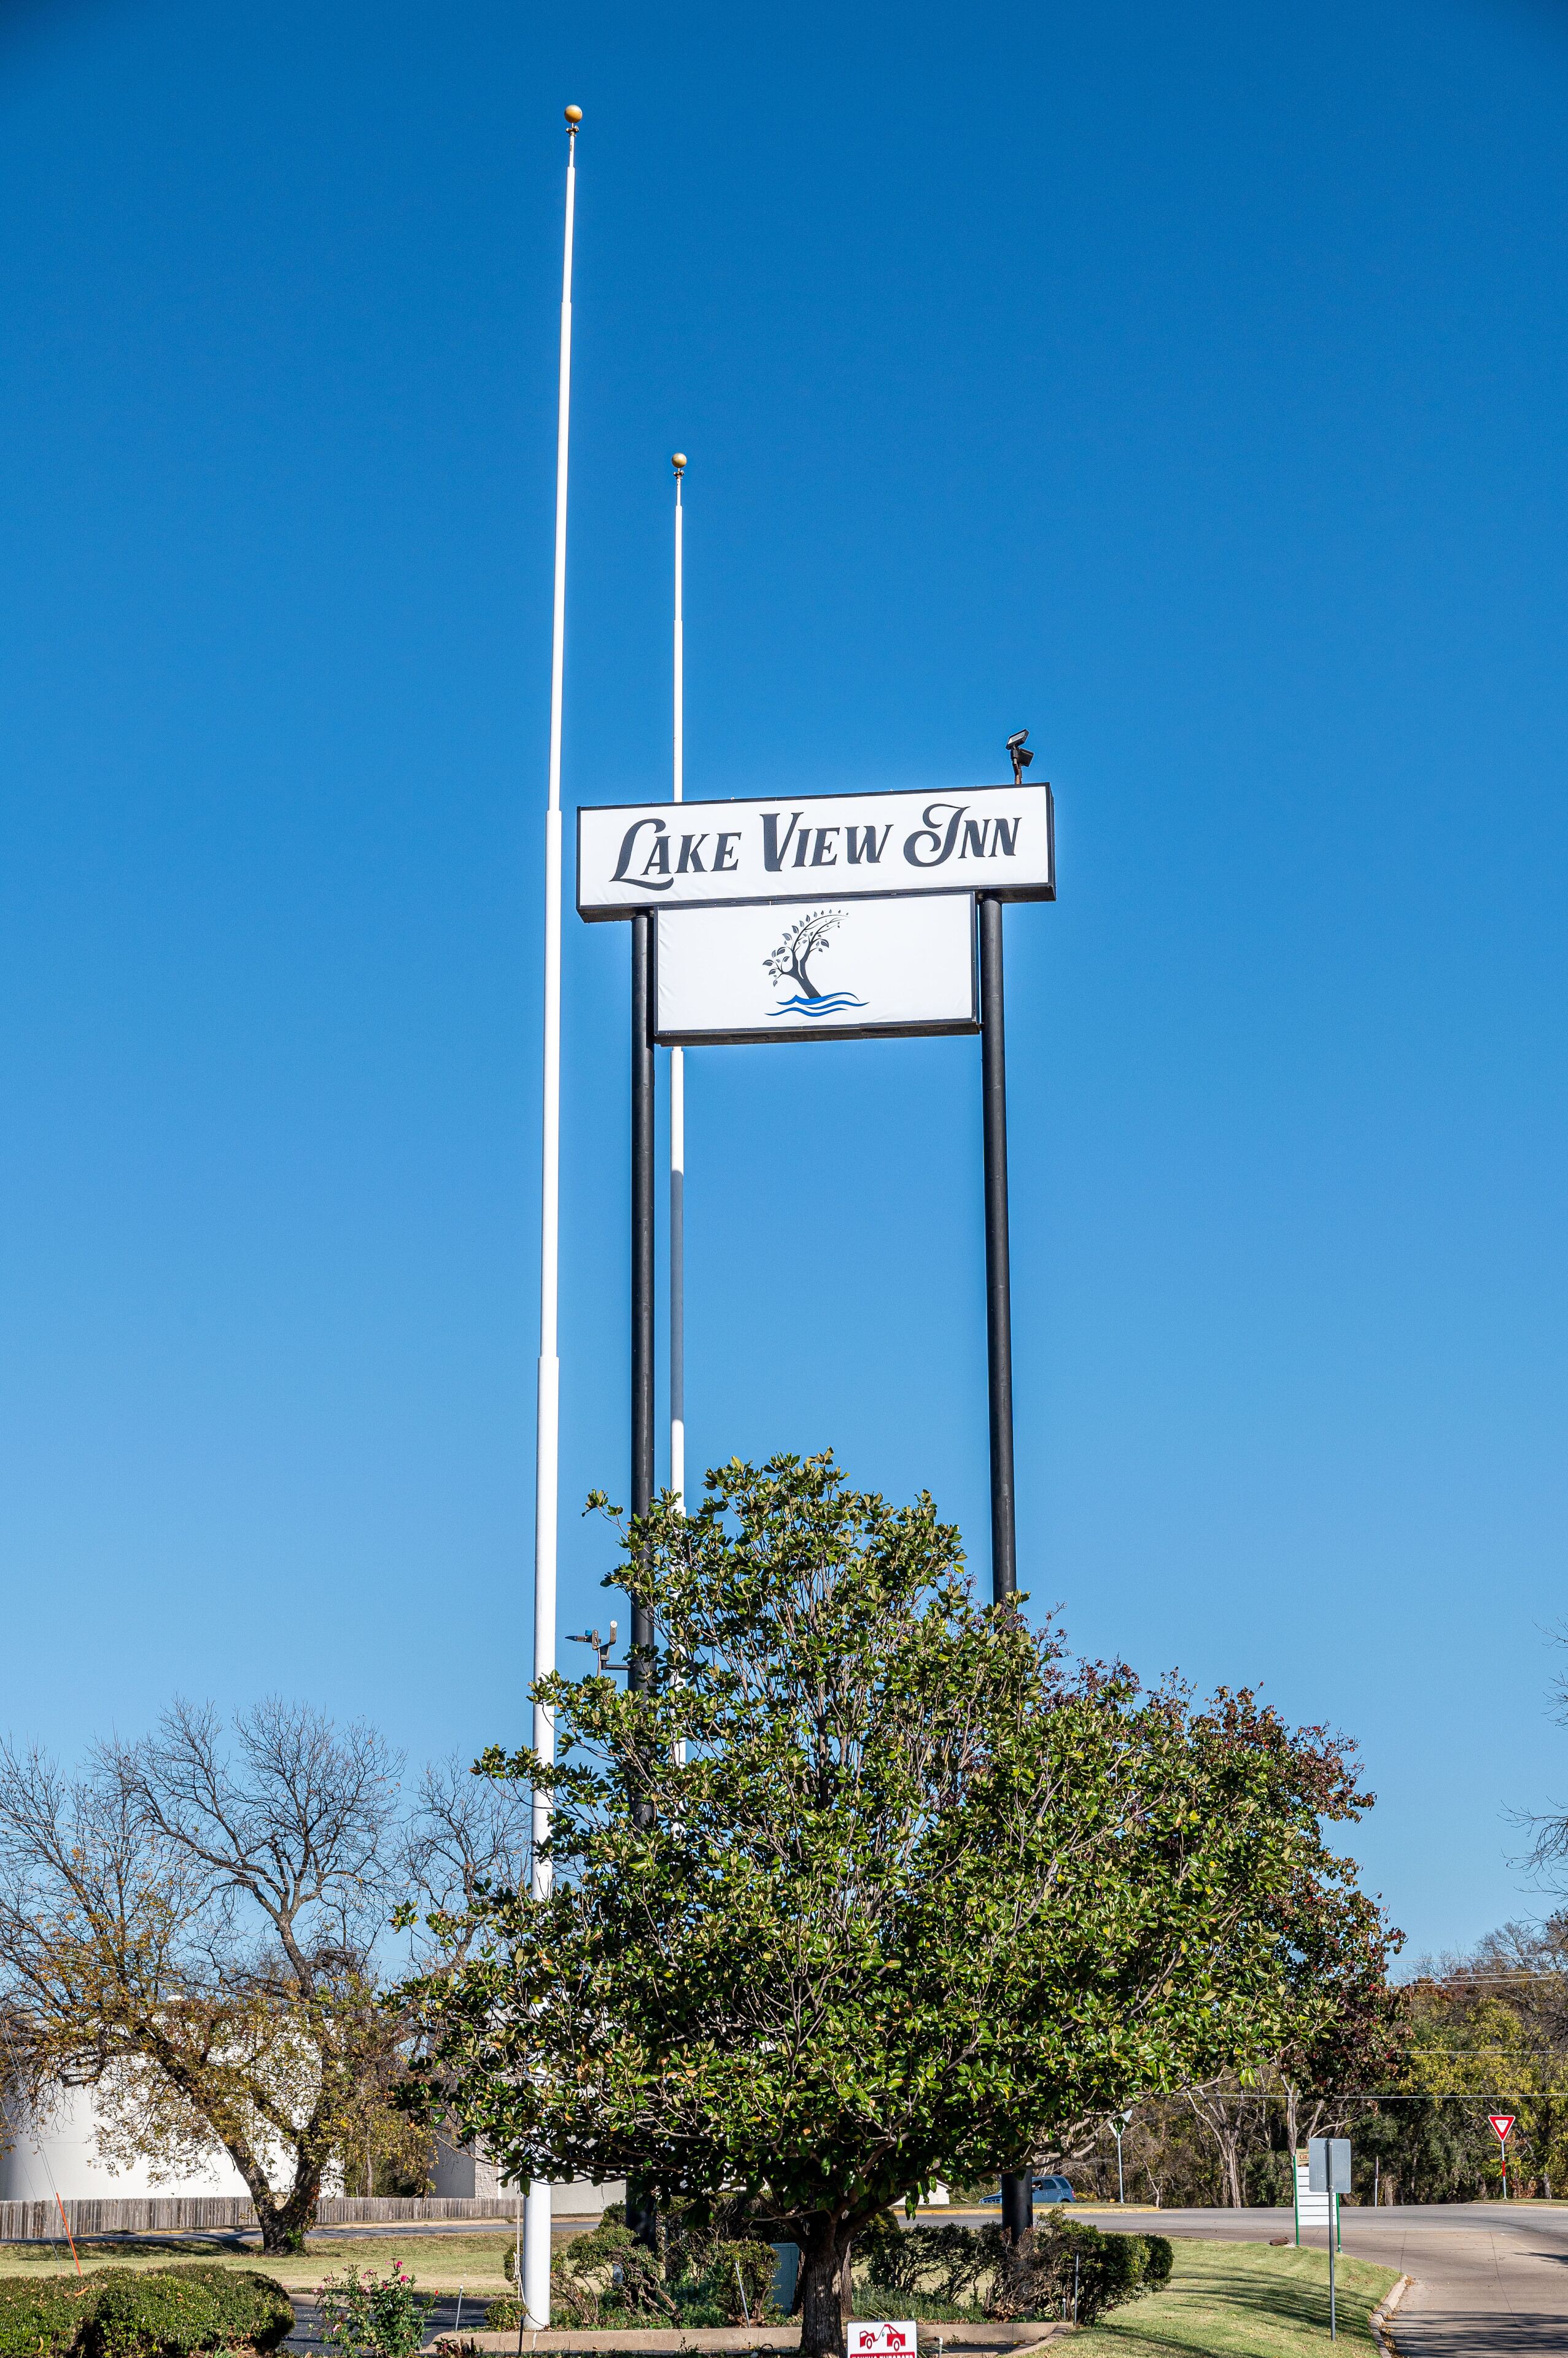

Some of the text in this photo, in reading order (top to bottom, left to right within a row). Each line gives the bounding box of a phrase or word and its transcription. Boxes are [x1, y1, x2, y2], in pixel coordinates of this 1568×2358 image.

[609, 803, 1022, 890] LAKE VIEW INN
